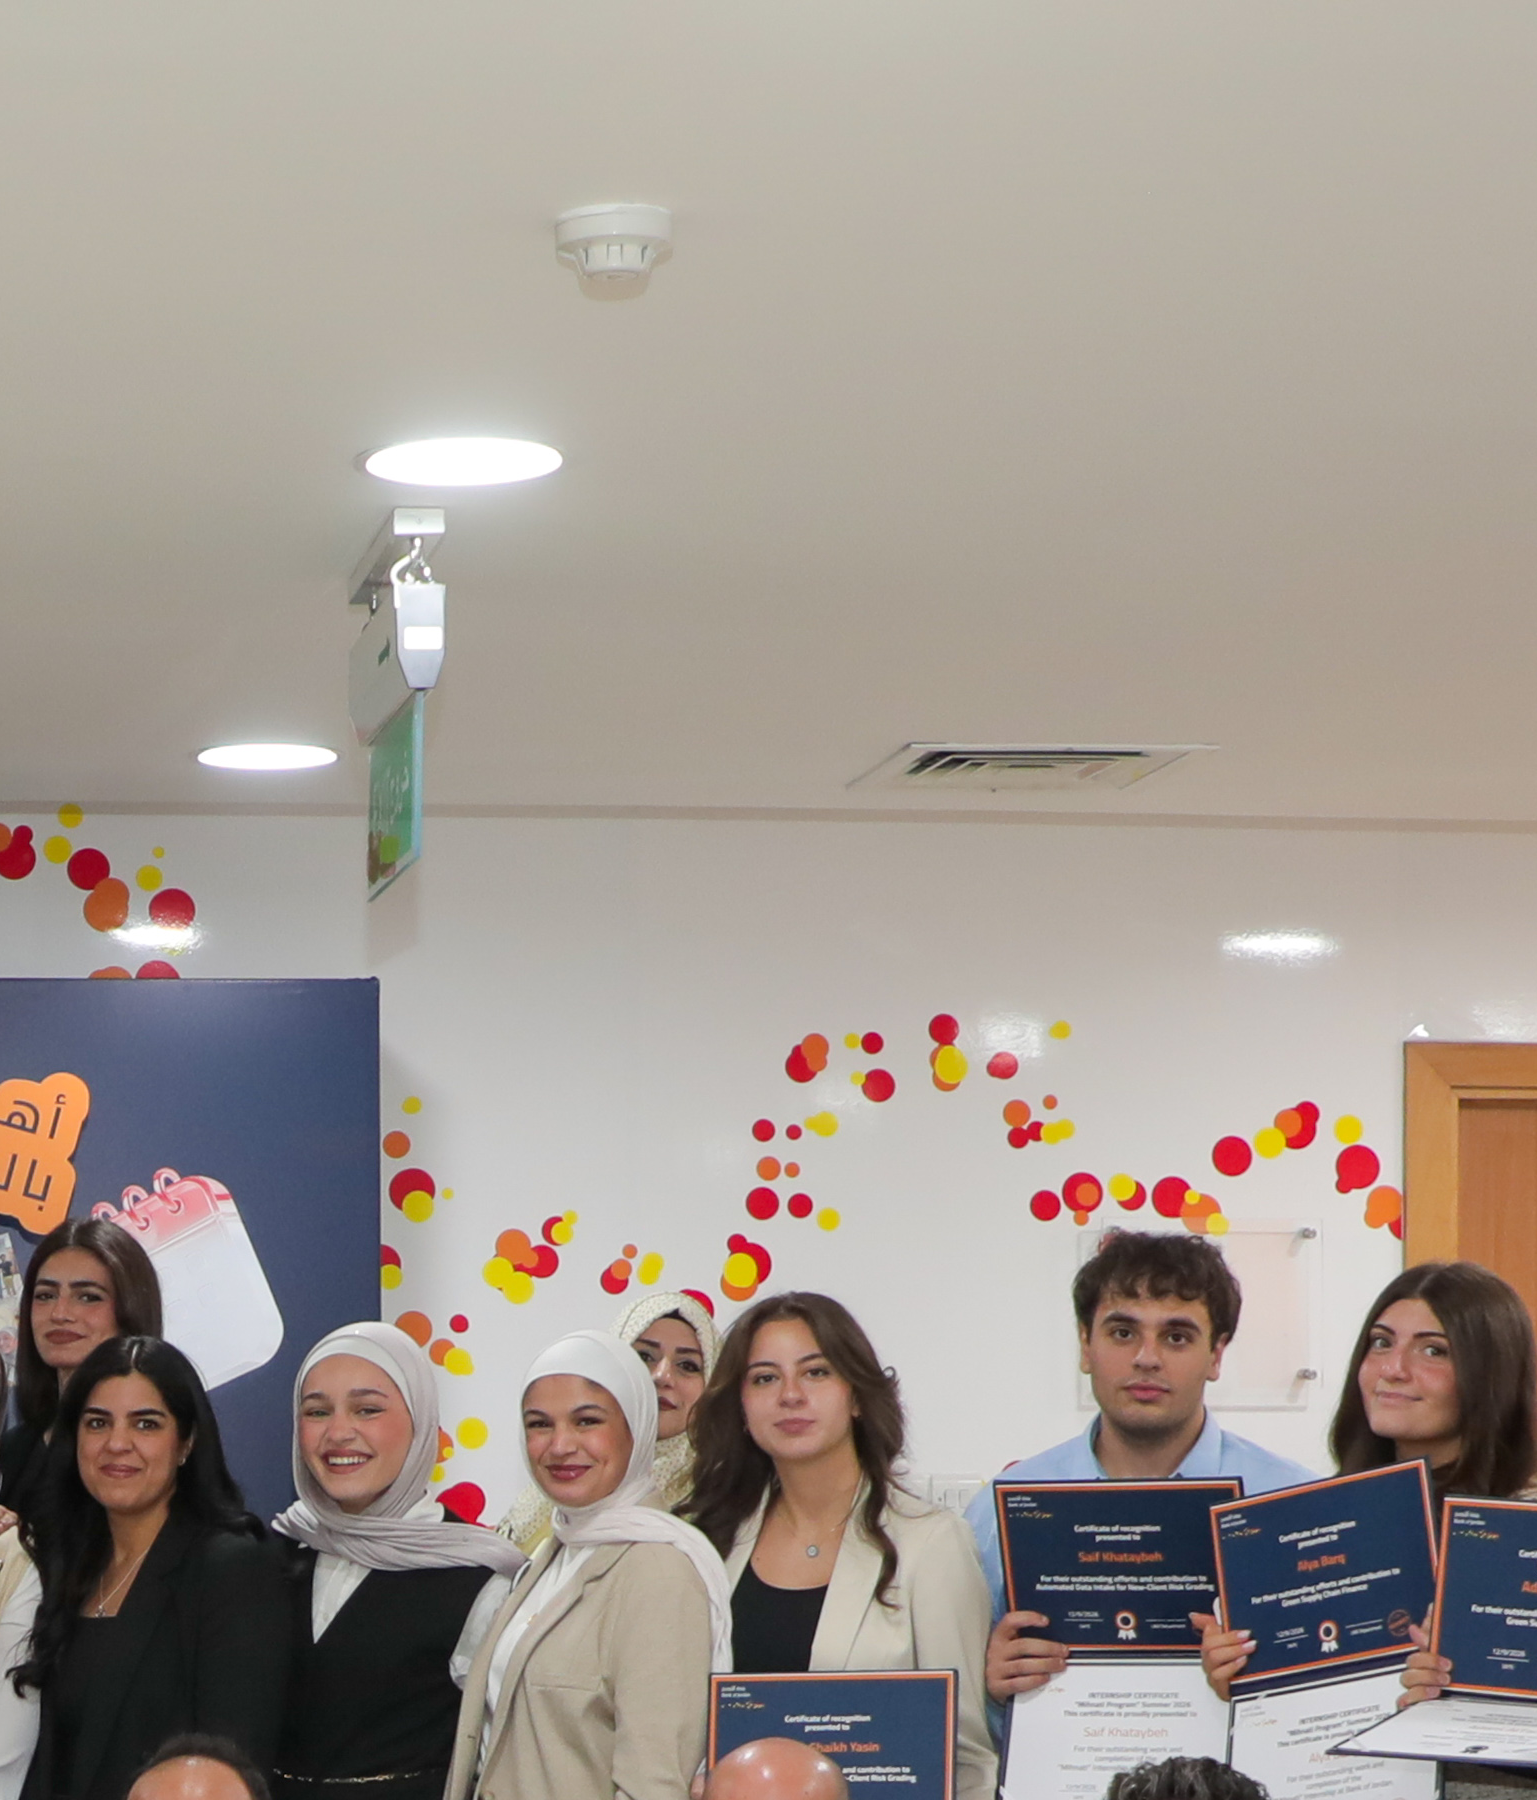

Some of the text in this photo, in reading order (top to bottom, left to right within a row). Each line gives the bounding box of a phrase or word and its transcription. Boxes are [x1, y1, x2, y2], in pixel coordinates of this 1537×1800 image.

[1074, 1525, 1111, 1533] Certificate
[1119, 1525, 1161, 1533] recognition
[1095, 1534, 1132, 1542] presented
[1078, 1552, 1101, 1562] Saif
[784, 1714, 871, 1724] Certificate of recognition
[850, 1742, 880, 1752] Yasin
